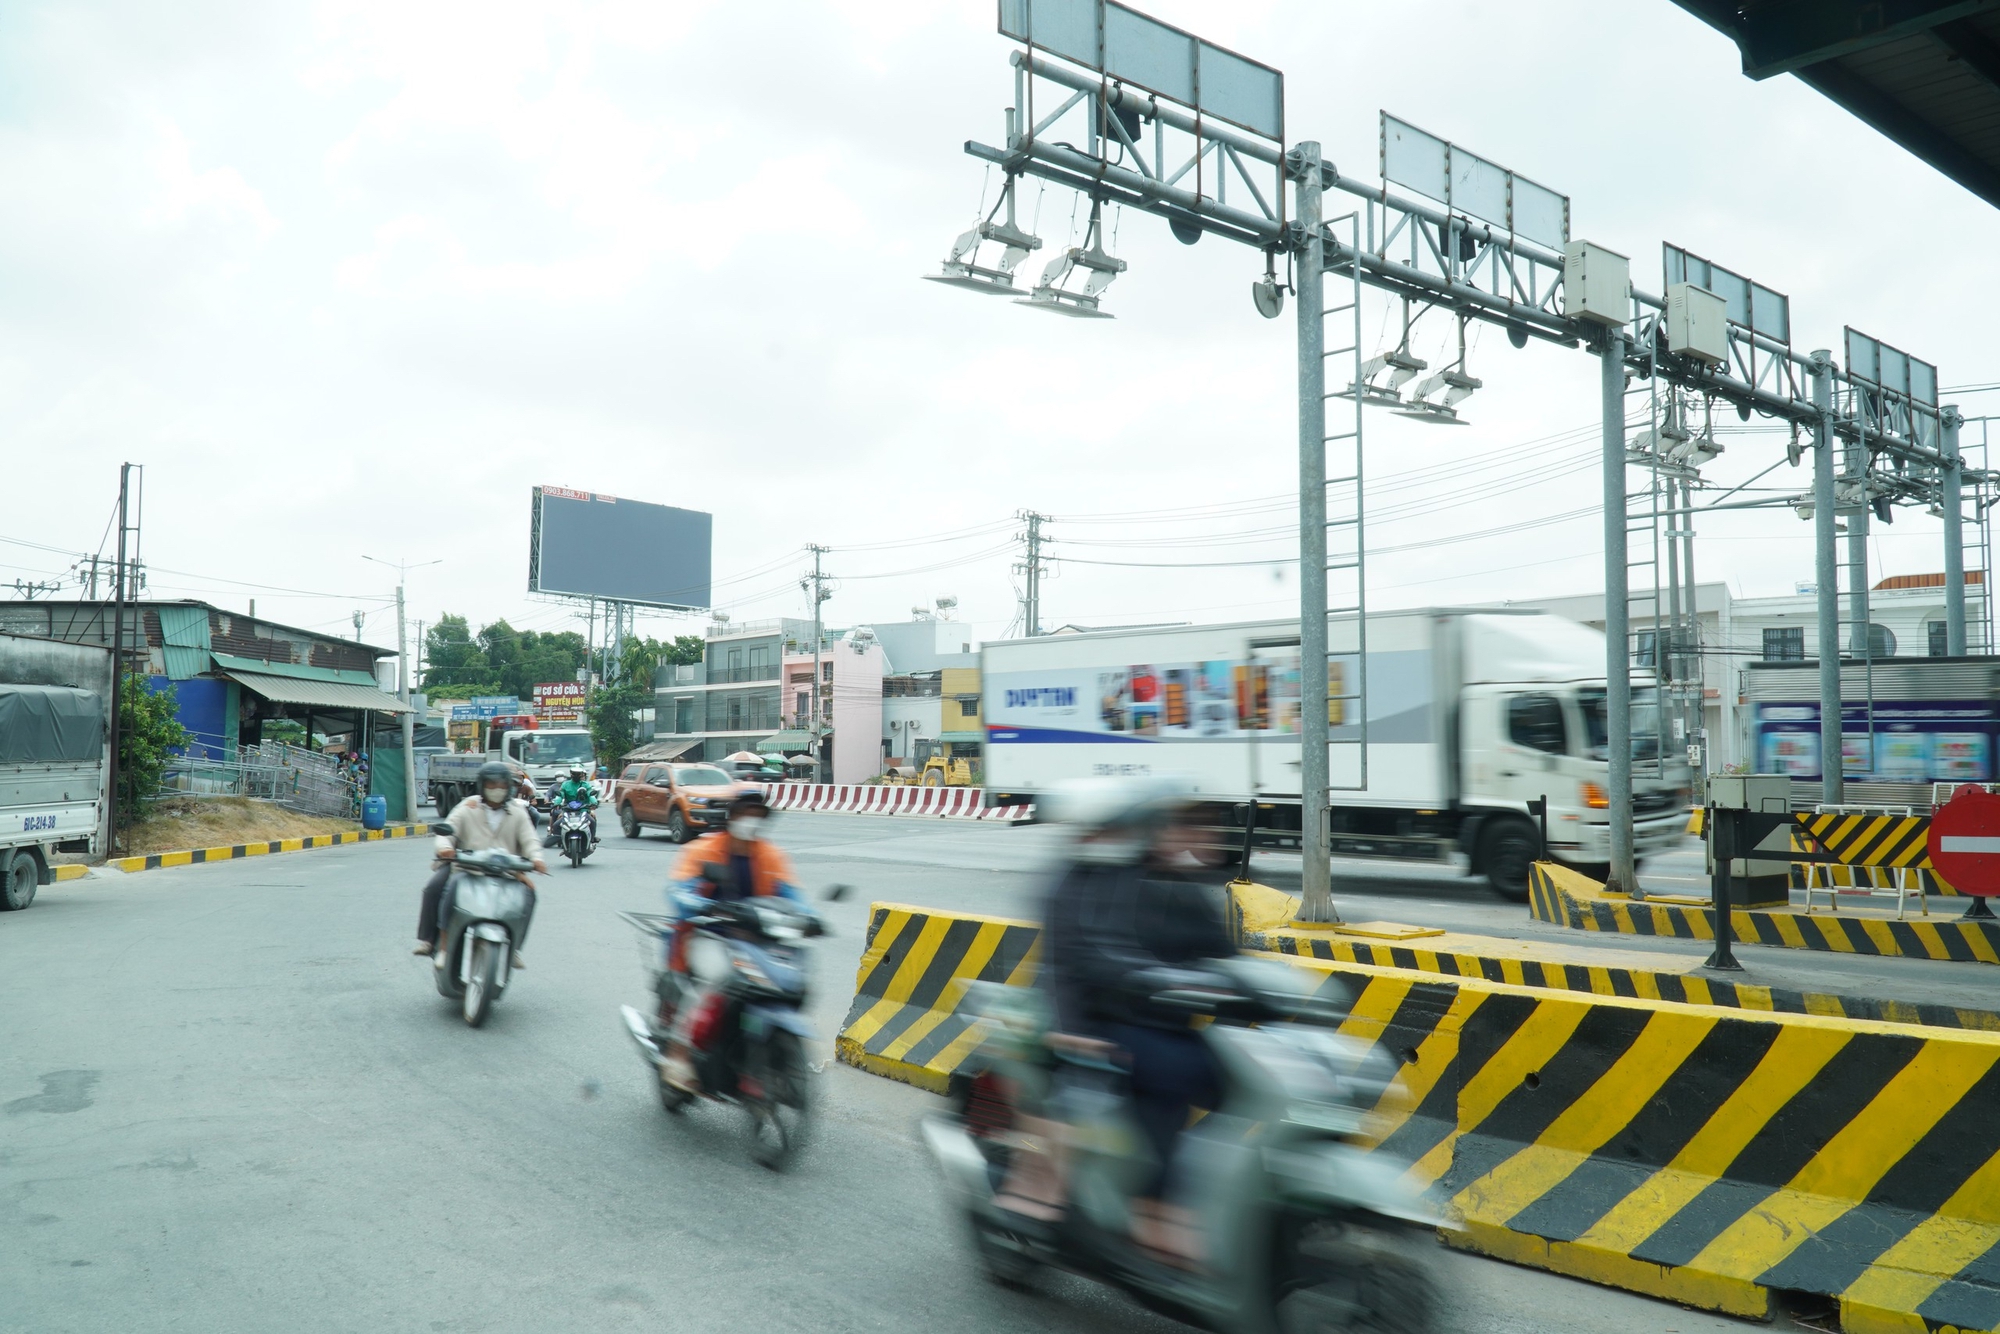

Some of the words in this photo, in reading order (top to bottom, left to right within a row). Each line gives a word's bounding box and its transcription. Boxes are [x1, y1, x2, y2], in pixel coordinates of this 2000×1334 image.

[543, 487, 588, 500] 0903.868.711
[542, 685, 552, 696] CƠ
[552, 683, 563, 695] SỞ
[564, 683, 579, 695] CỬA
